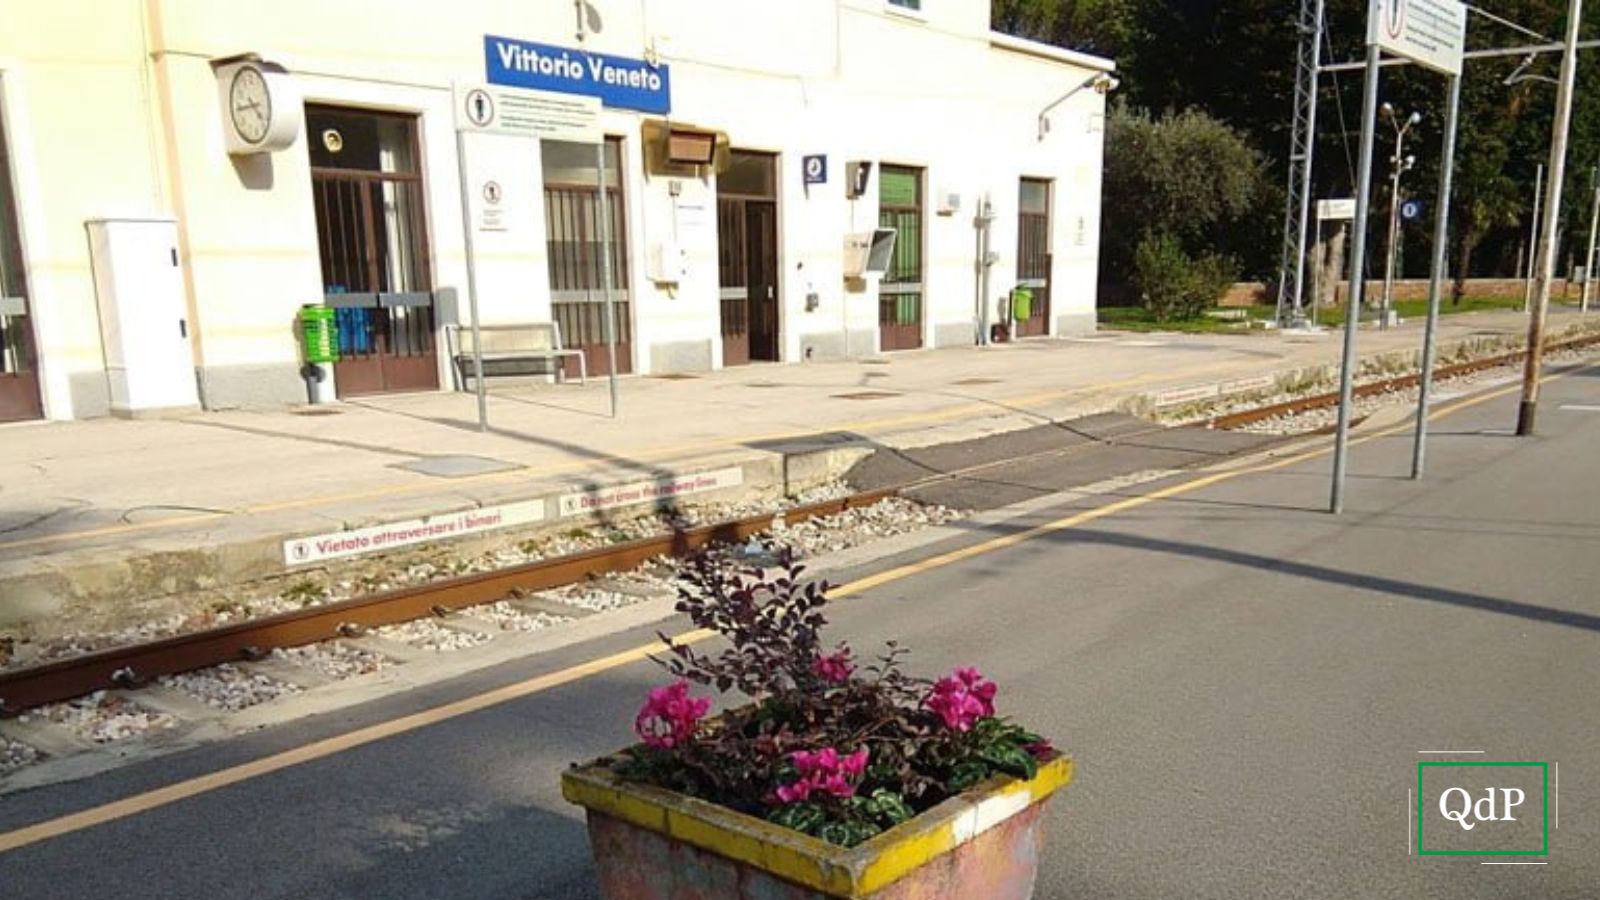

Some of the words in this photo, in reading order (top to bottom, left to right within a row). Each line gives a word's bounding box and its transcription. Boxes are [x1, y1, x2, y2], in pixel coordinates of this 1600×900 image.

[498, 43, 583, 79] Vittorio
[589, 57, 661, 90] Veneto
[316, 536, 370, 554] Vietato
[373, 521, 455, 545] attraversare
[458, 518, 464, 530] i
[466, 512, 503, 526] binari
